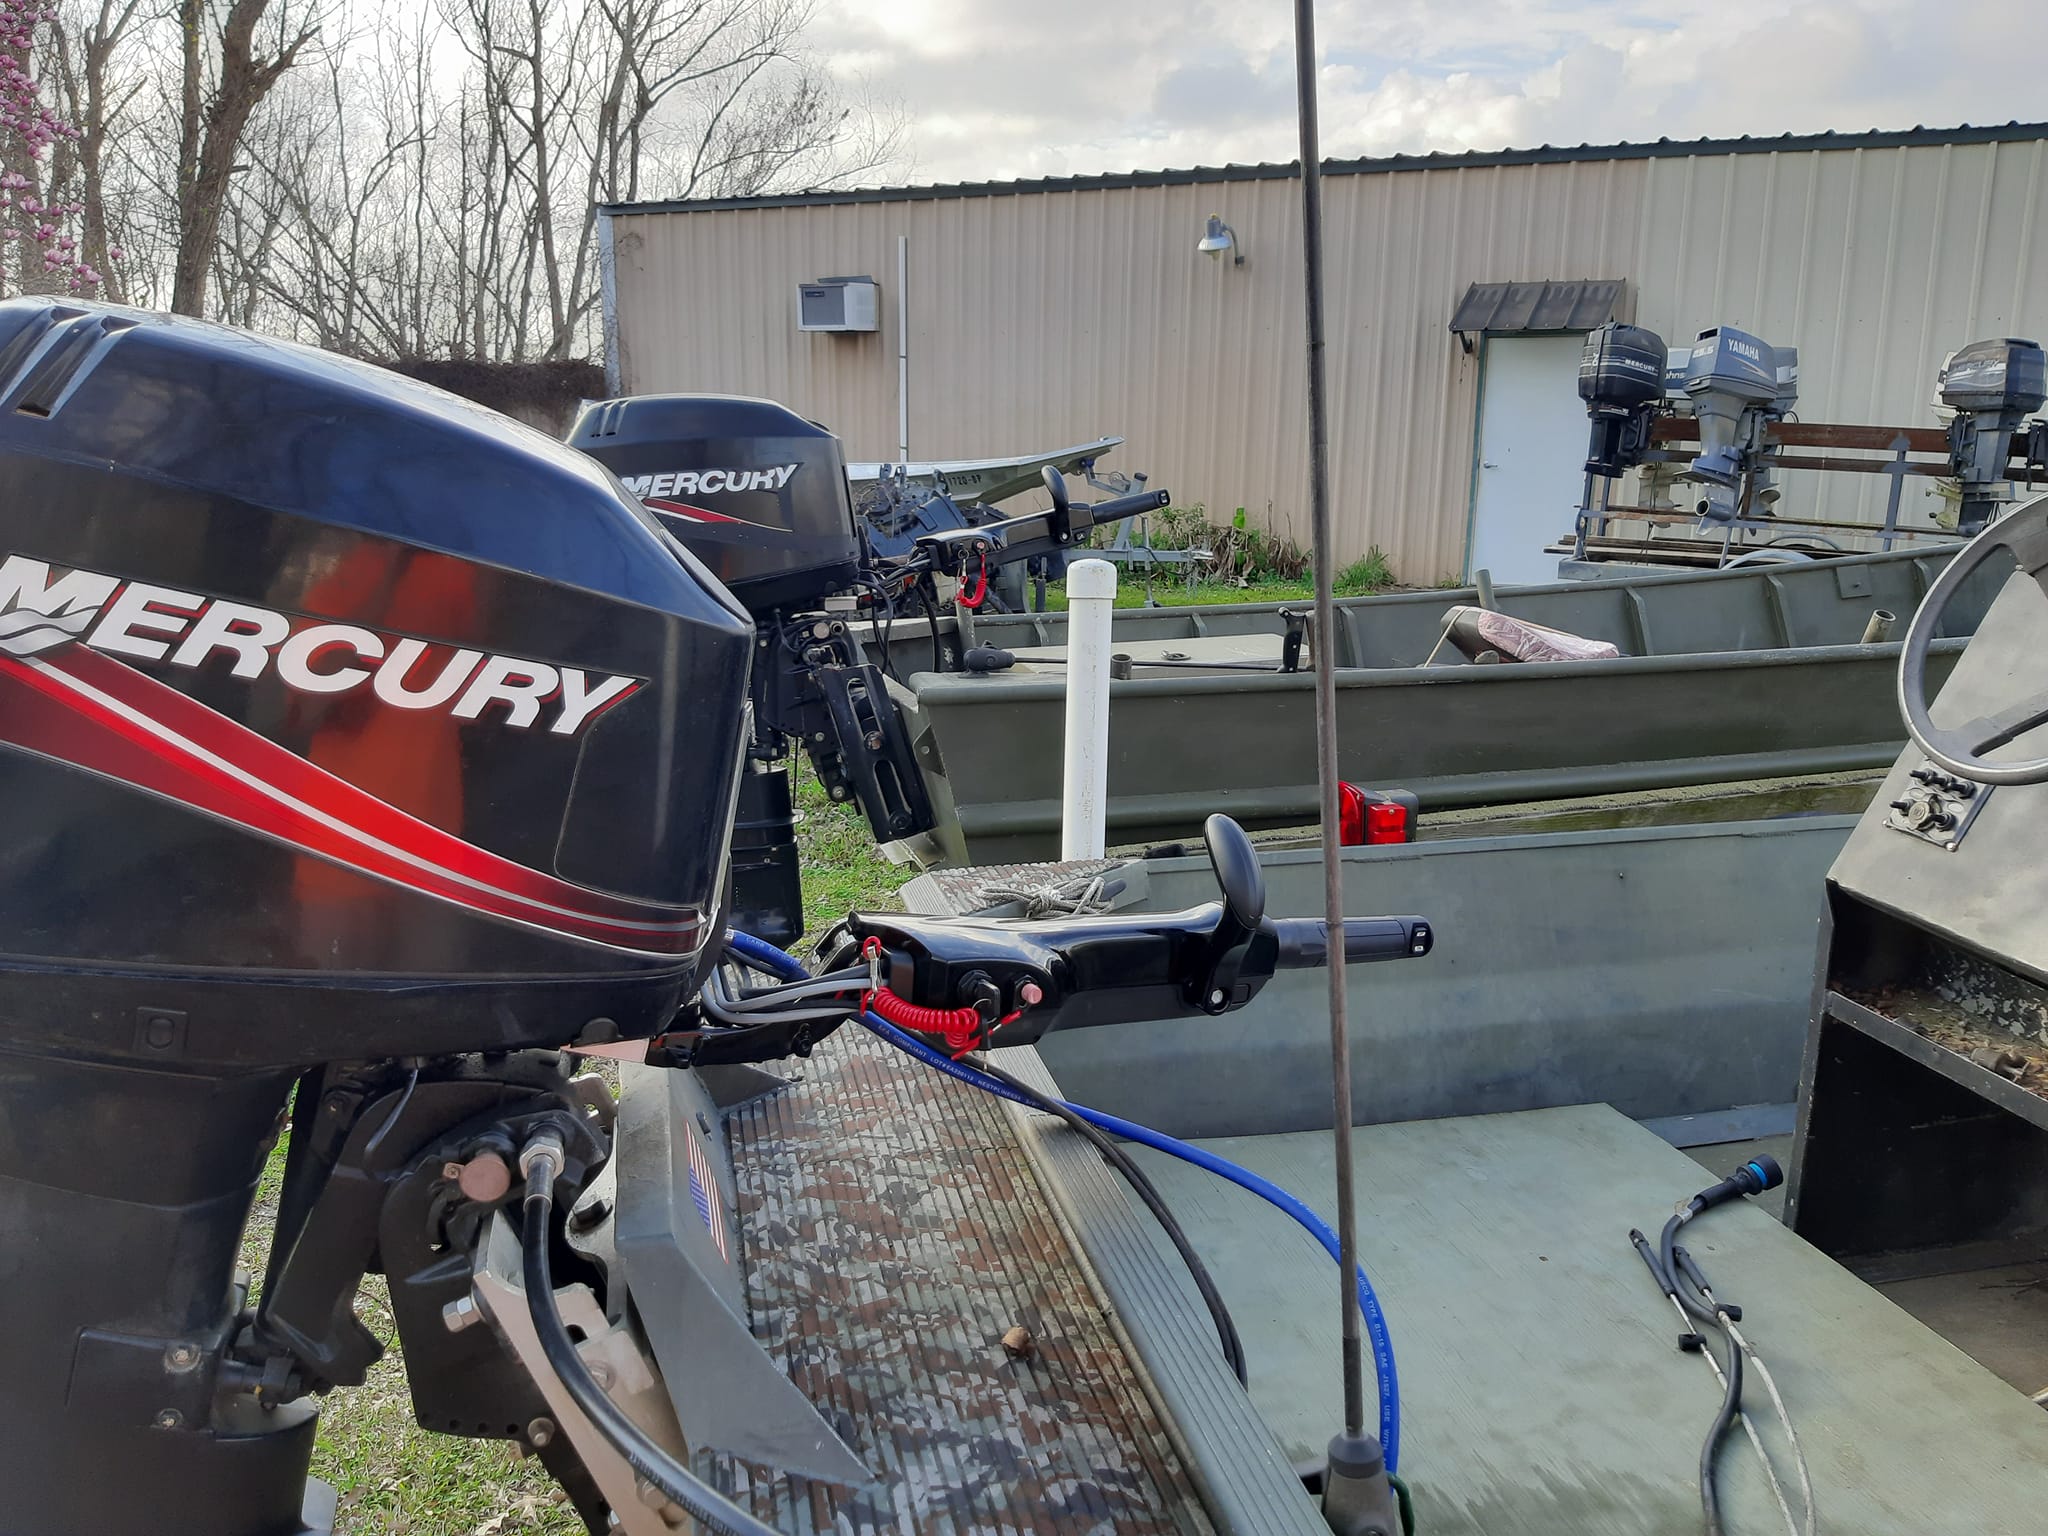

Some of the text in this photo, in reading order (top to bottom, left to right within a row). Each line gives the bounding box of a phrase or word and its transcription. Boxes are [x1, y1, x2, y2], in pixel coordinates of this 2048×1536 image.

[1727, 338, 1760, 362] YAMAHA
[1624, 358, 1657, 373] MERCURY
[621, 464, 798, 501] MERCURY
[0, 554, 639, 734] MERCURY
[893, 1034, 927, 1058] COMPLIANT
[1367, 1300, 1378, 1318] TYPE
[1383, 1404, 1391, 1422] USE
